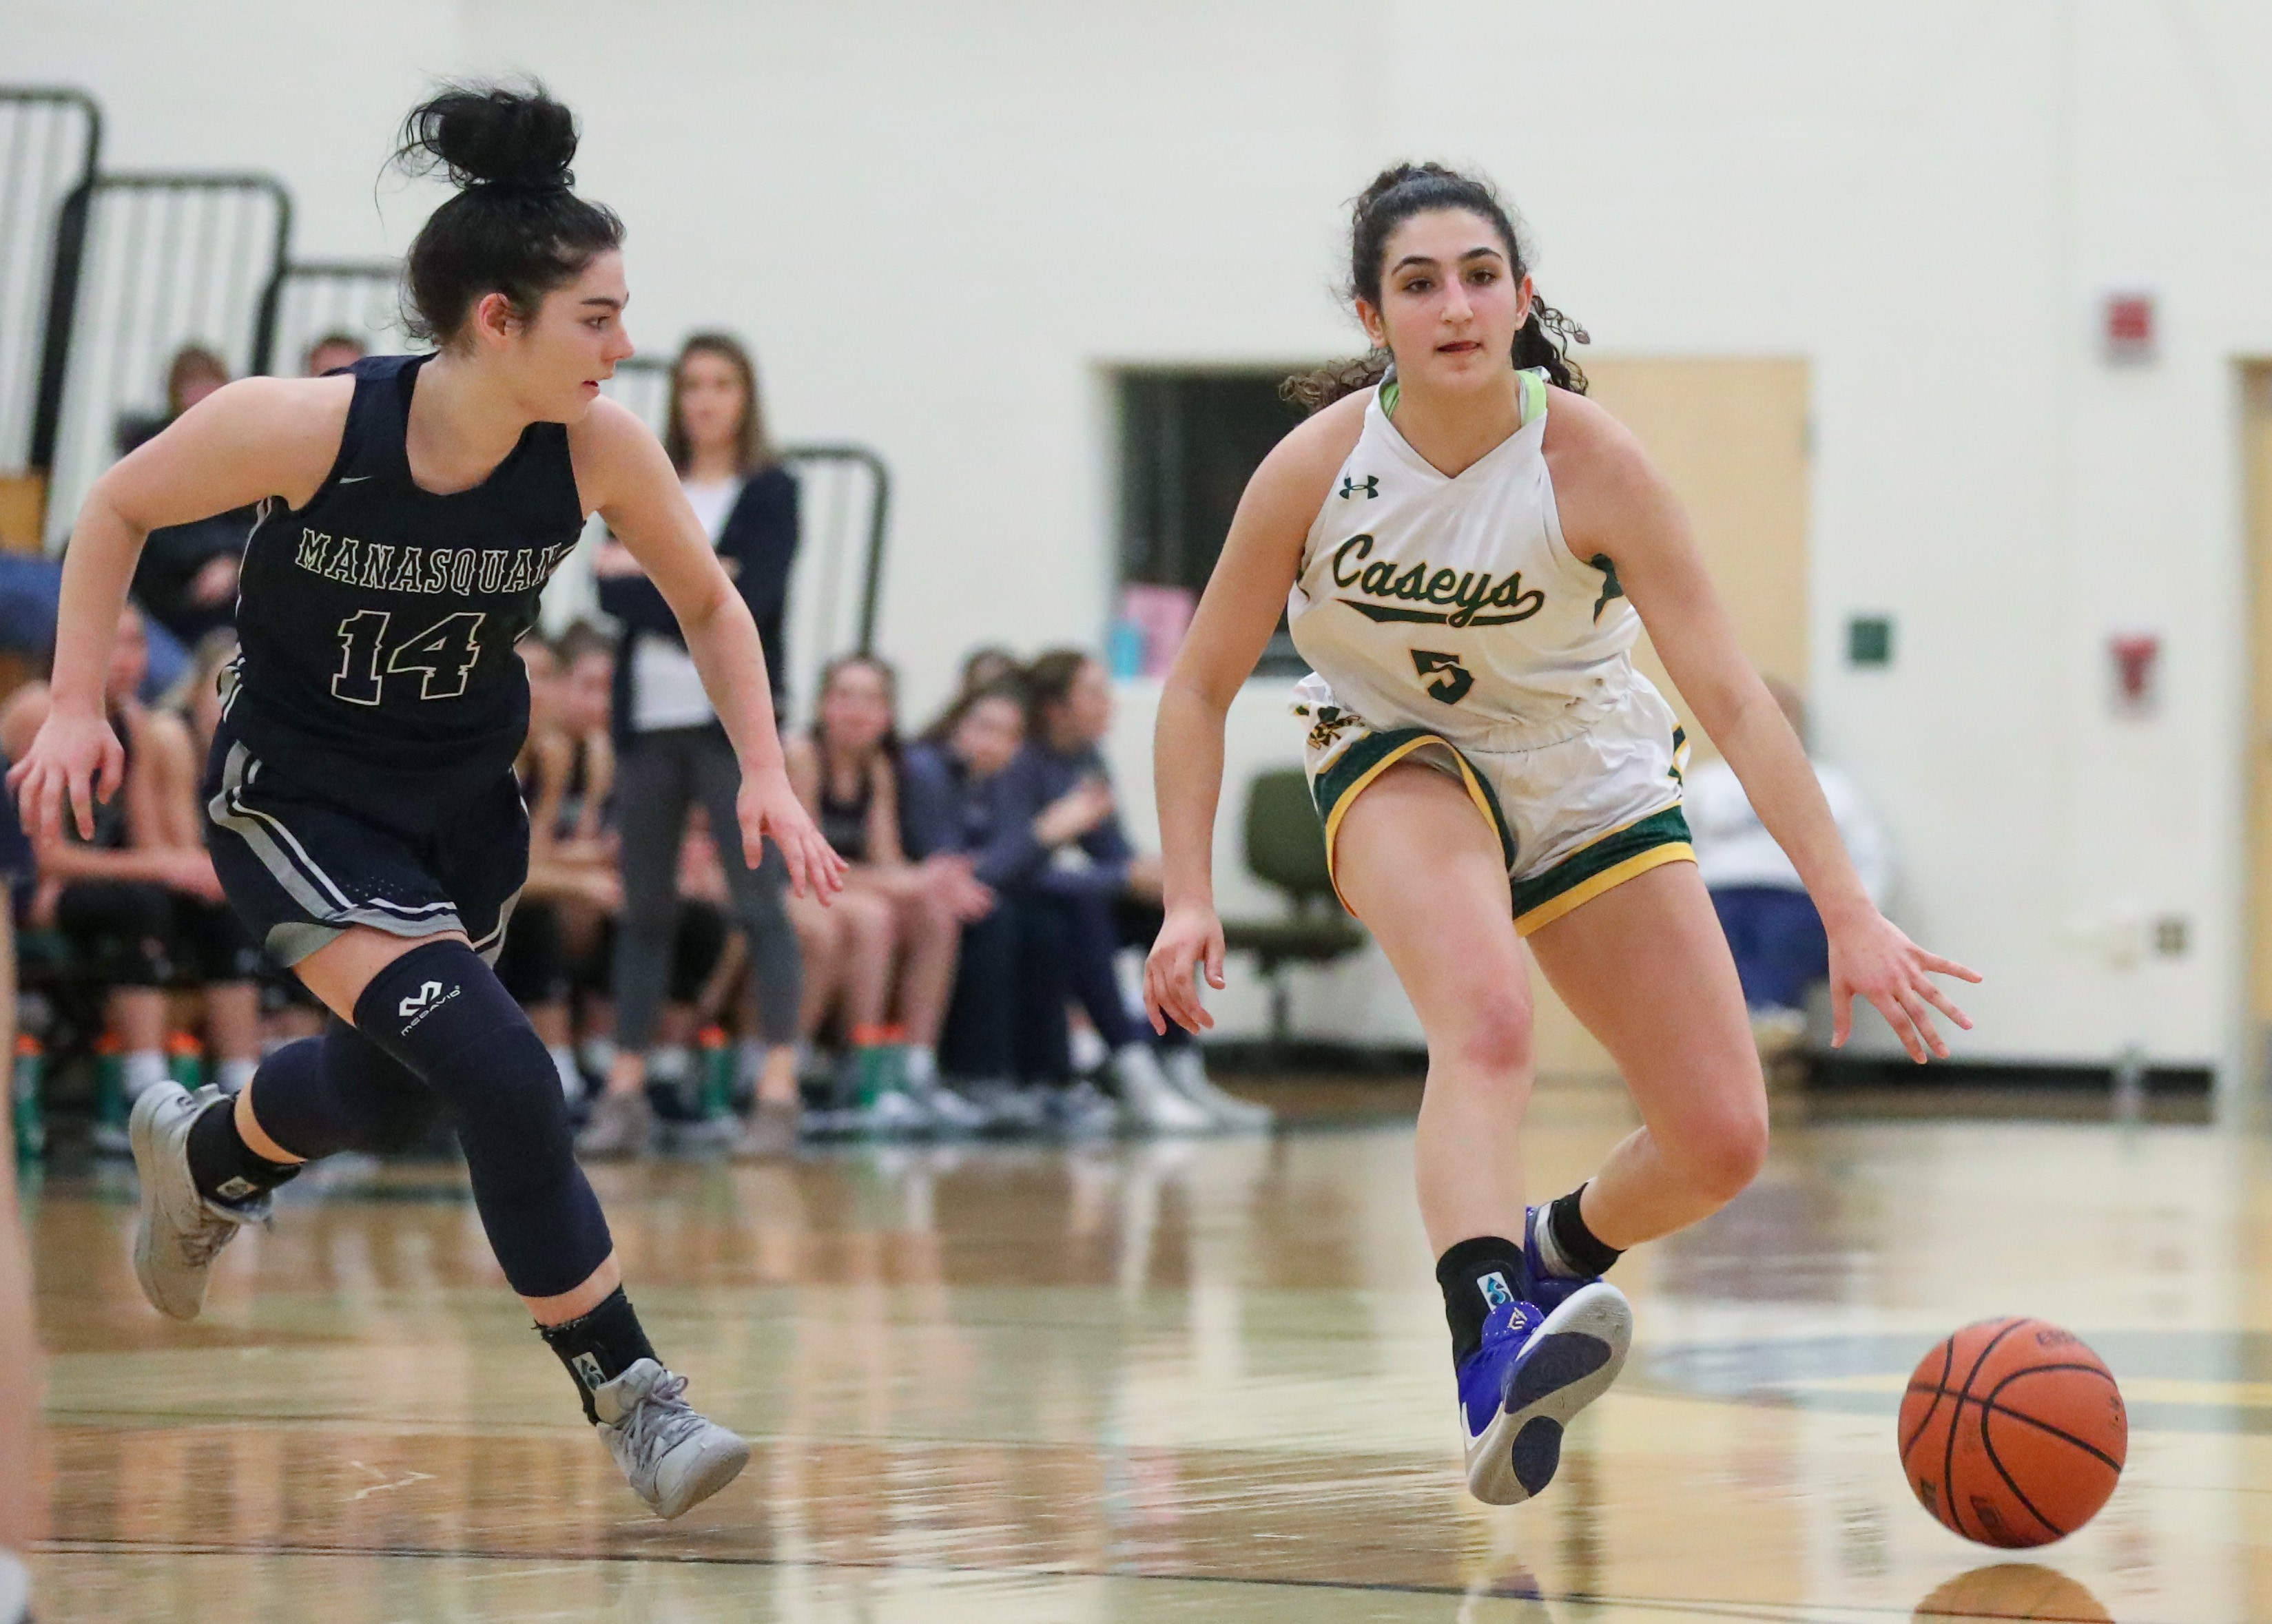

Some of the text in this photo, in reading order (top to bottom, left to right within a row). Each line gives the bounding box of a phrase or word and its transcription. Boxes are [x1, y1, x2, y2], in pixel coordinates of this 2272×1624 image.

[1333, 534, 1545, 628] Caseys
[331, 610, 486, 705] 14
[1409, 649, 1475, 705] 5
